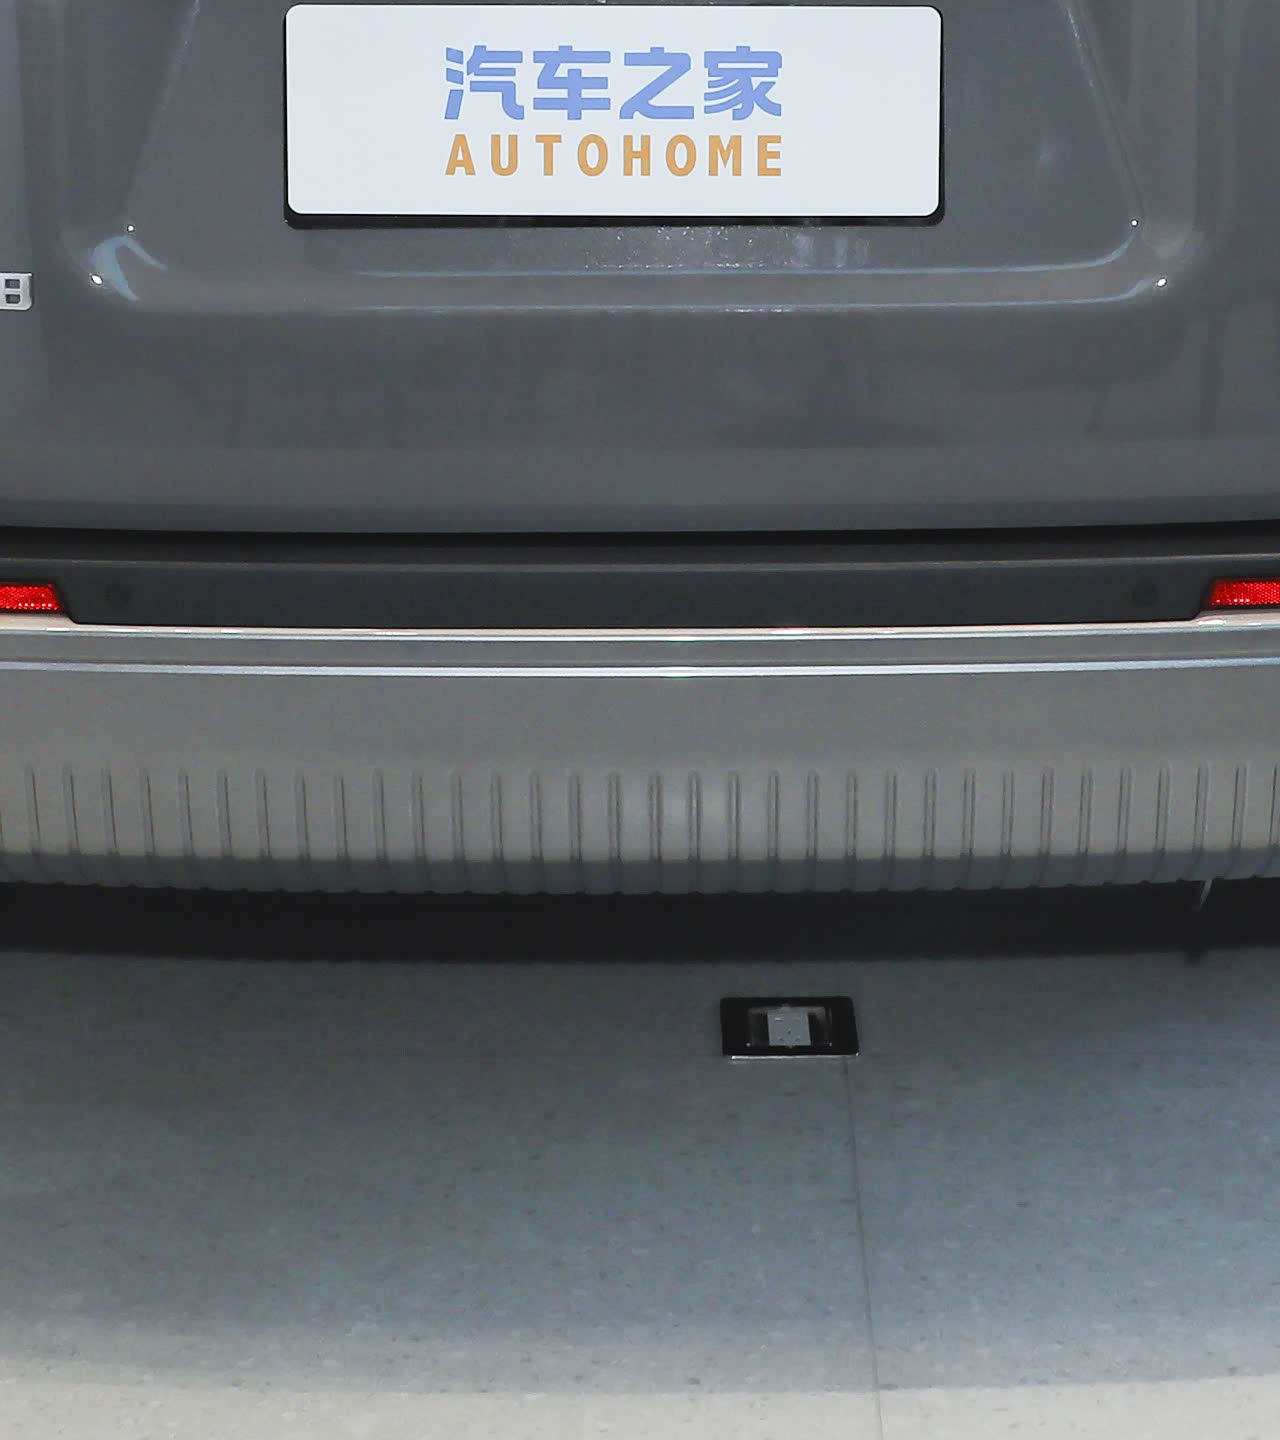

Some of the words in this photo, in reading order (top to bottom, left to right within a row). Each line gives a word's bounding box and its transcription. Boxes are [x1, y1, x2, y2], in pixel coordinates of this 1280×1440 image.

[443, 45, 783, 122] 汽车之家
[444, 133, 783, 178] AUTOHOME
